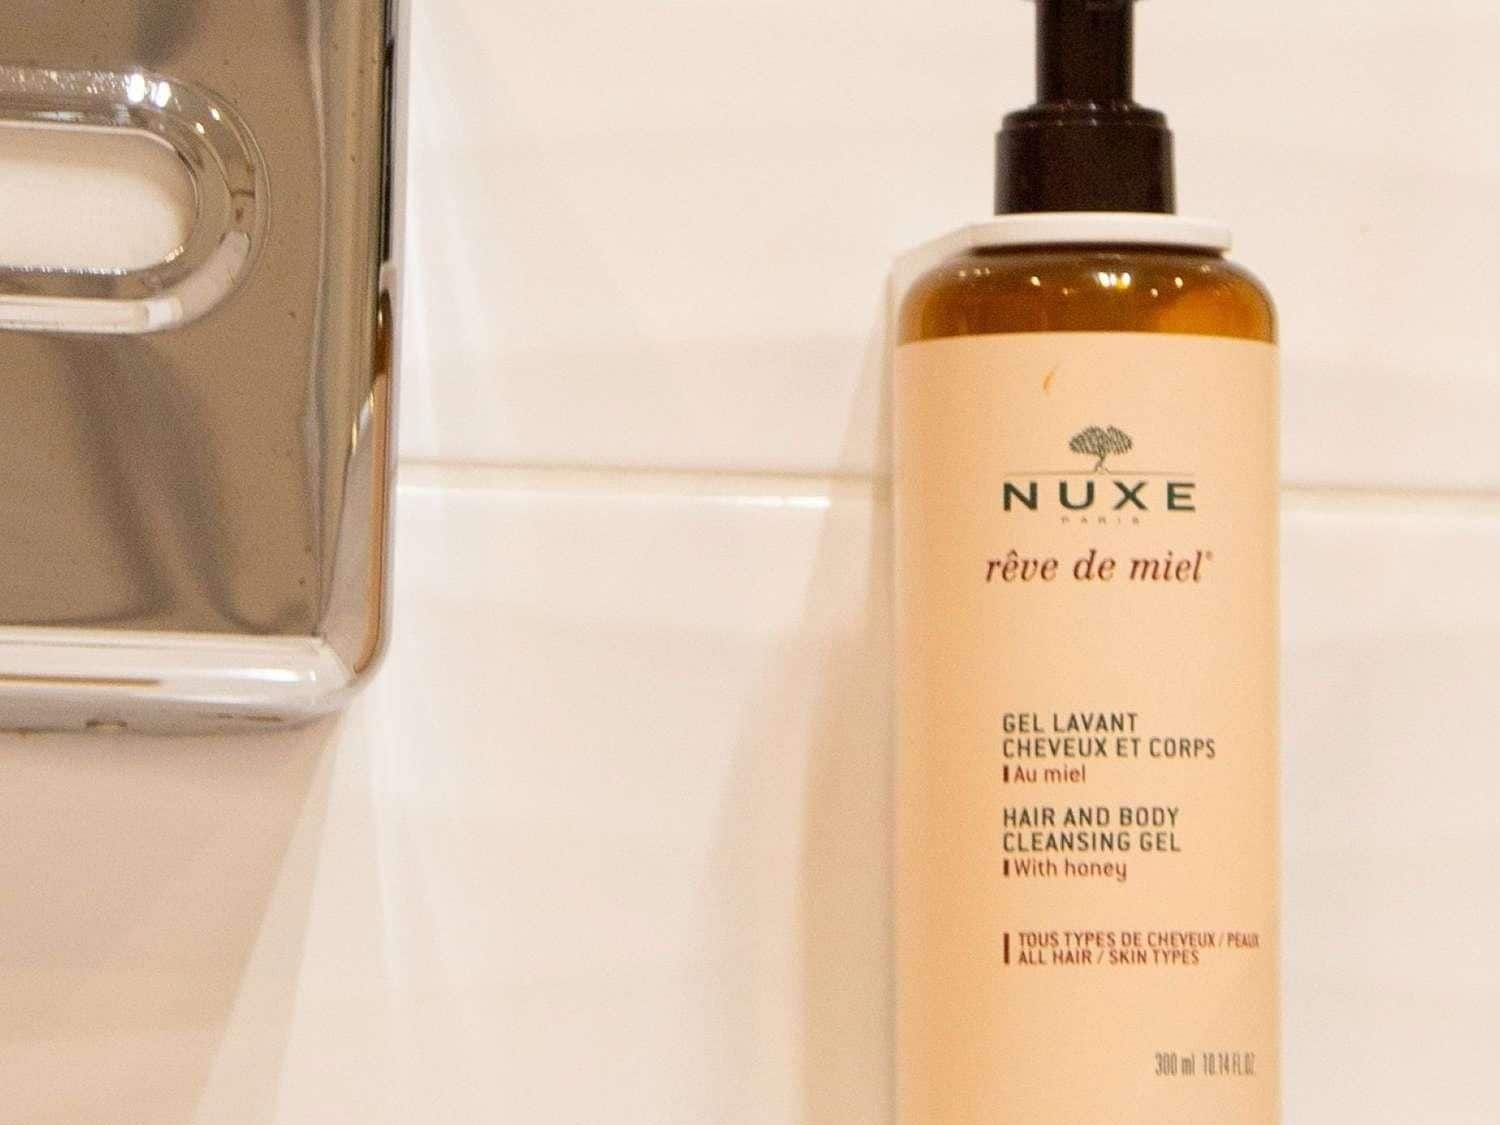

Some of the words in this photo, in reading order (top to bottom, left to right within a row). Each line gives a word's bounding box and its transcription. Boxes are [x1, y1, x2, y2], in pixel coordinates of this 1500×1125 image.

[1003, 481, 1196, 511] NUXE
[985, 549, 1058, 583] rêve
[1073, 549, 1116, 583] de
[1002, 713, 1044, 733] GEL
[1053, 713, 1138, 733] LAVANT
[1002, 738, 1107, 758] CHEVEUX
[1115, 738, 1141, 758] ET
[1149, 738, 1216, 758] CORPS
[1014, 766, 1037, 783] Au
[1044, 764, 1086, 783] miel
[1003, 807, 1055, 827] HAIR
[1063, 807, 1110, 827] AND
[1119, 807, 1179, 827] BODY
[1003, 832, 1131, 852] CLEANSING
[1139, 833, 1181, 852] GEL
[1014, 859, 1057, 877] With
[1064, 859, 1127, 881] honey
[1018, 932, 1059, 948] TOUS
[1065, 932, 1116, 948] TYPES
[1121, 932, 1142, 948] DE
[1147, 932, 1215, 948] CHEVEUX
[1018, 949, 1047, 965] ALL
[1052, 949, 1092, 965] HAIR
[1109, 949, 1147, 965] SKIN
[1153, 949, 1200, 965] TYPES
[1154, 1052, 1178, 1076] 300
[1181, 1053, 1196, 1076] ml
